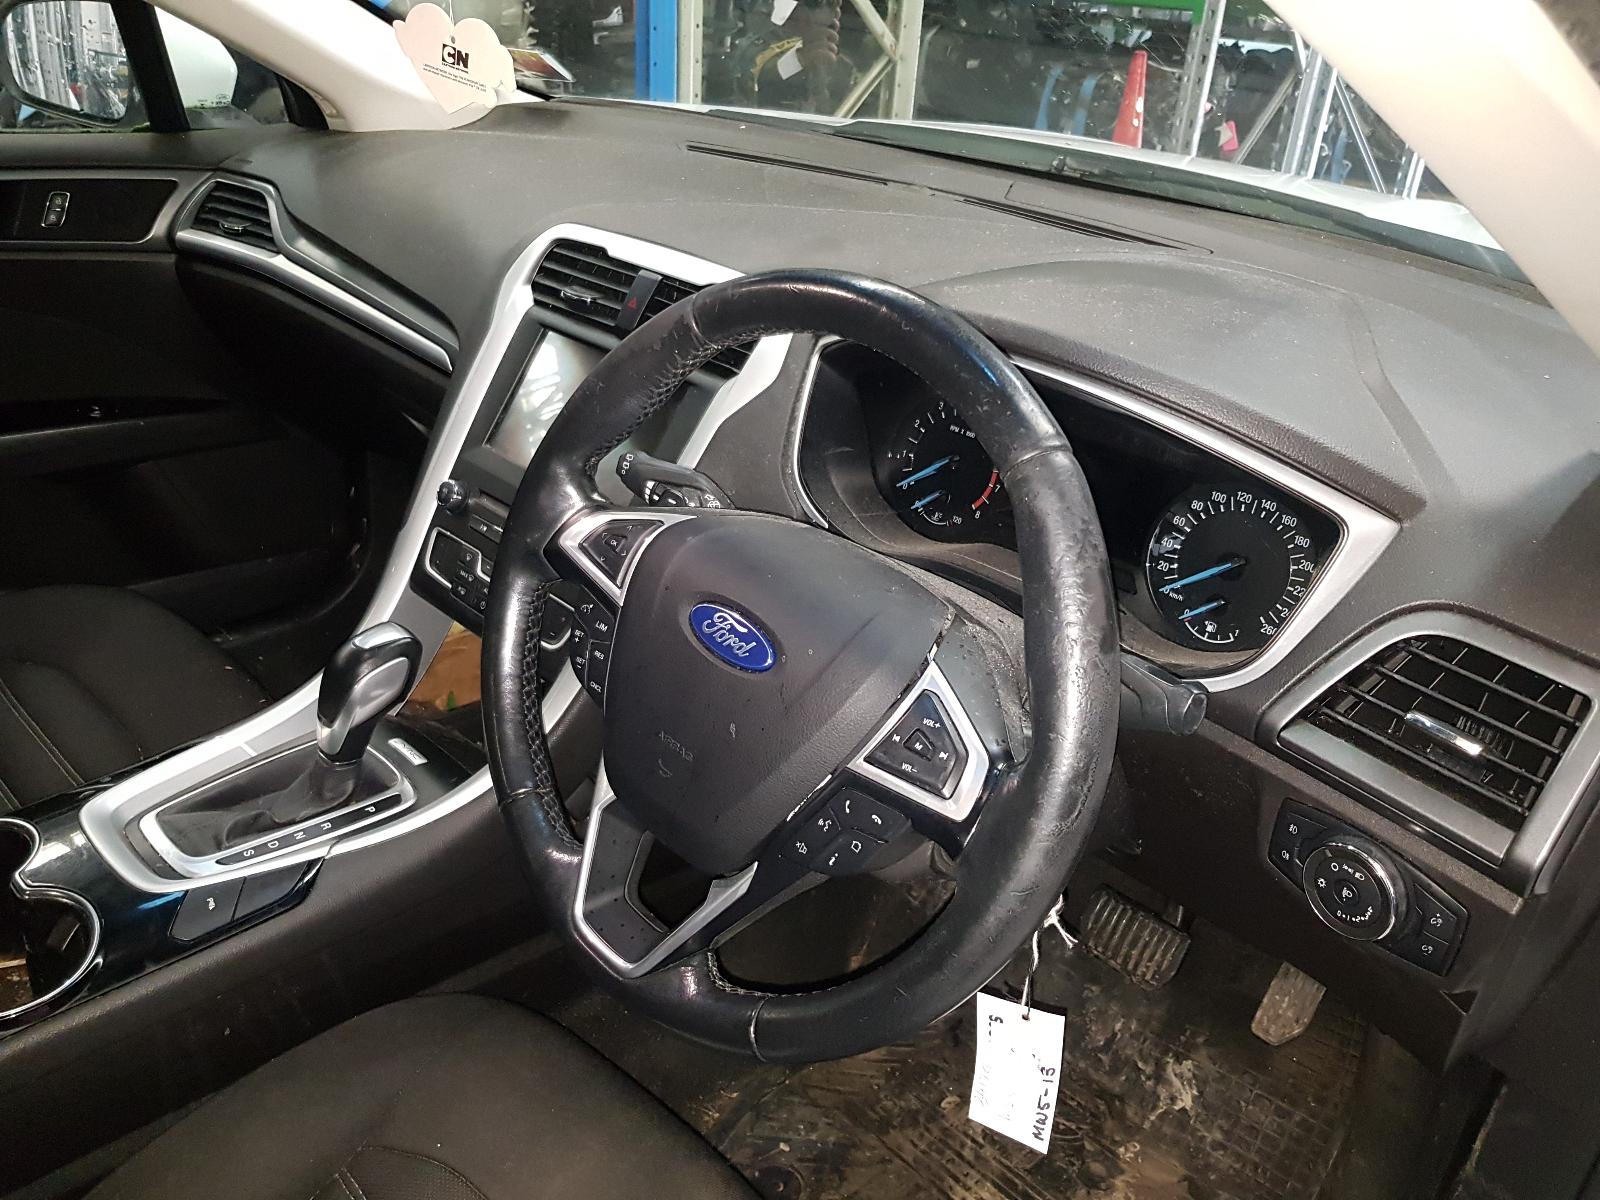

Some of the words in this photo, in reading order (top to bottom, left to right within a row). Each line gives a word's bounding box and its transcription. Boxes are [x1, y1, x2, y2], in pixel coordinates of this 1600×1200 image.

[442, 43, 470, 69] CN
[914, 419, 921, 428] 2
[995, 485, 1001, 493] 7
[1211, 491, 1227, 504] 100
[1236, 491, 1252, 504] 120
[1191, 500, 1203, 511] 80
[1260, 499, 1277, 512] 140
[974, 510, 981, 519] 8
[1173, 516, 1186, 528] 60
[1281, 514, 1297, 527] 160
[1160, 537, 1173, 548] 40
[1294, 535, 1310, 549] 180
[1157, 560, 1169, 572] 20
[1169, 592, 1184, 602] km/h
[595, 620, 608, 633] LIM
[574, 629, 585, 638] SET
[702, 612, 757, 657] Ford
[594, 650, 605, 660] RES
[576, 656, 586, 665] SET
[914, 741, 924, 751] M
[364, 805, 376, 814] P
[320, 821, 332, 831] R
[294, 831, 306, 840] N
[268, 840, 279, 849] D
[243, 849, 255, 857] S
